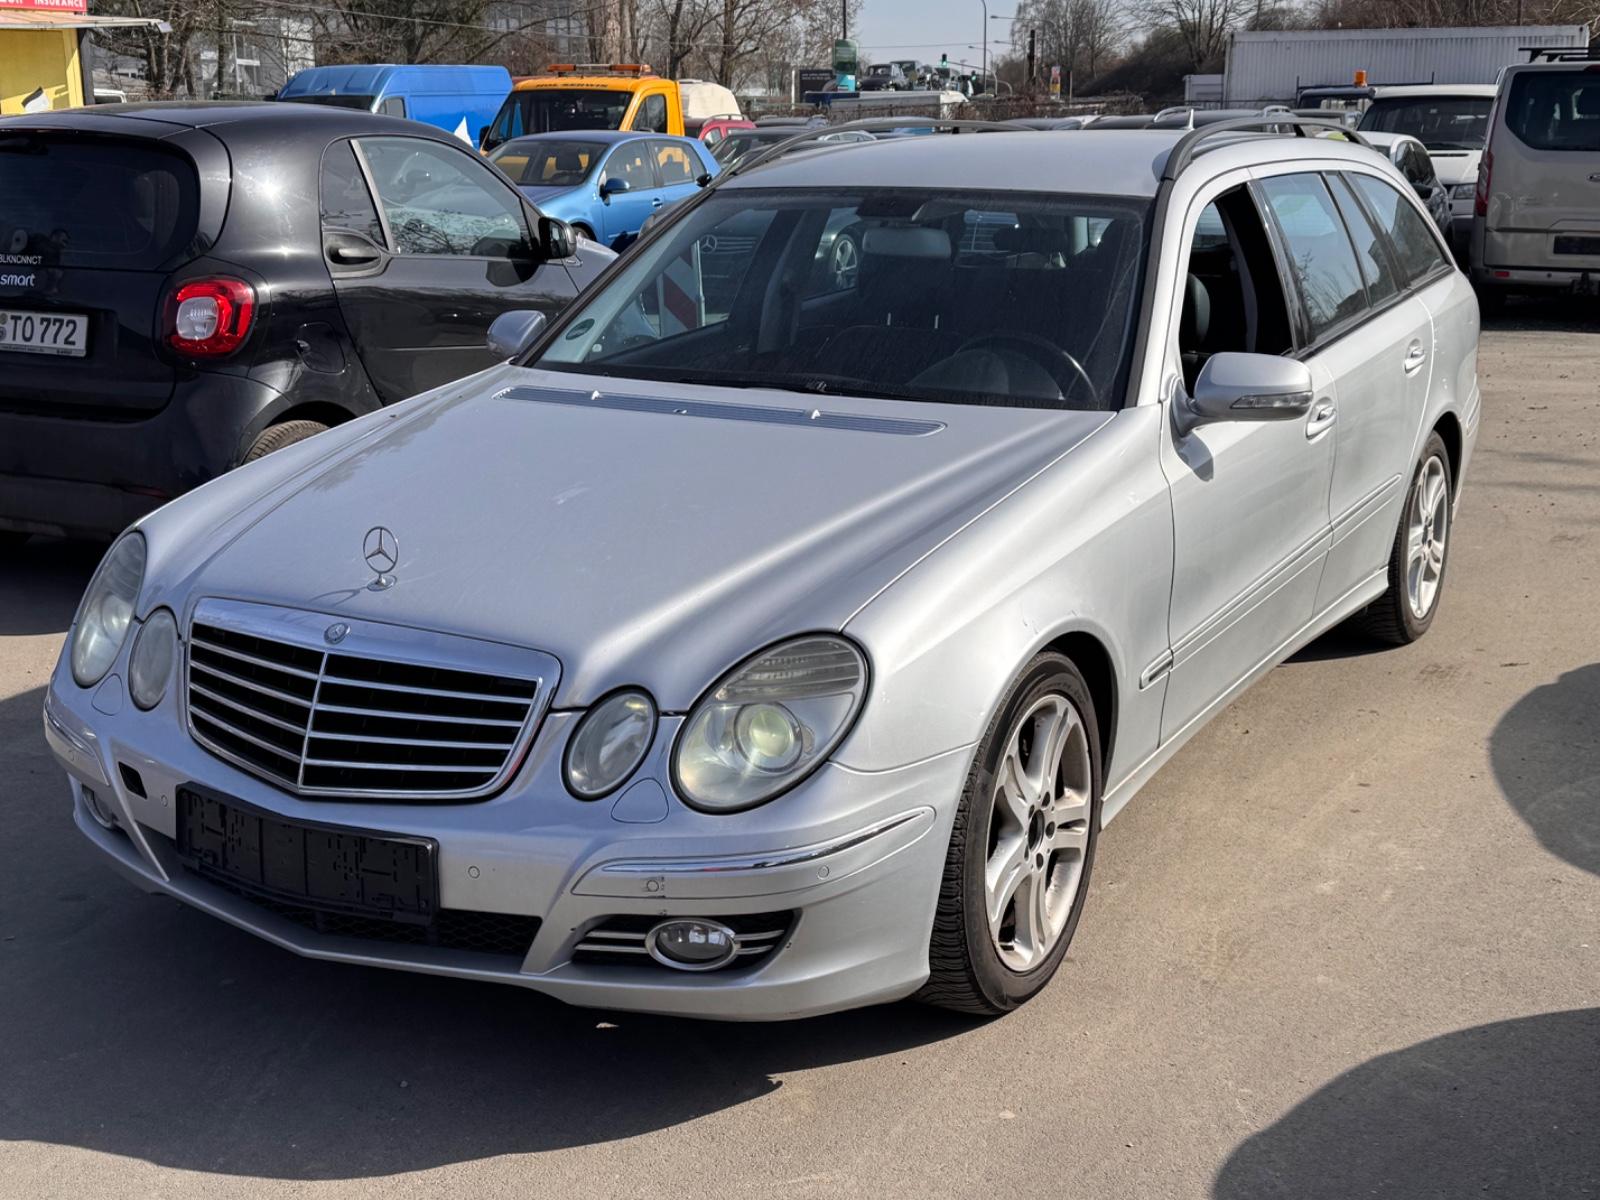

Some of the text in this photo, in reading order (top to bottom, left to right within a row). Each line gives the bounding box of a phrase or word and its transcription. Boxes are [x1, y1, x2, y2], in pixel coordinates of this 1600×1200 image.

[0, 273, 36, 287] smart
[10, 314, 77, 346] TO 772
